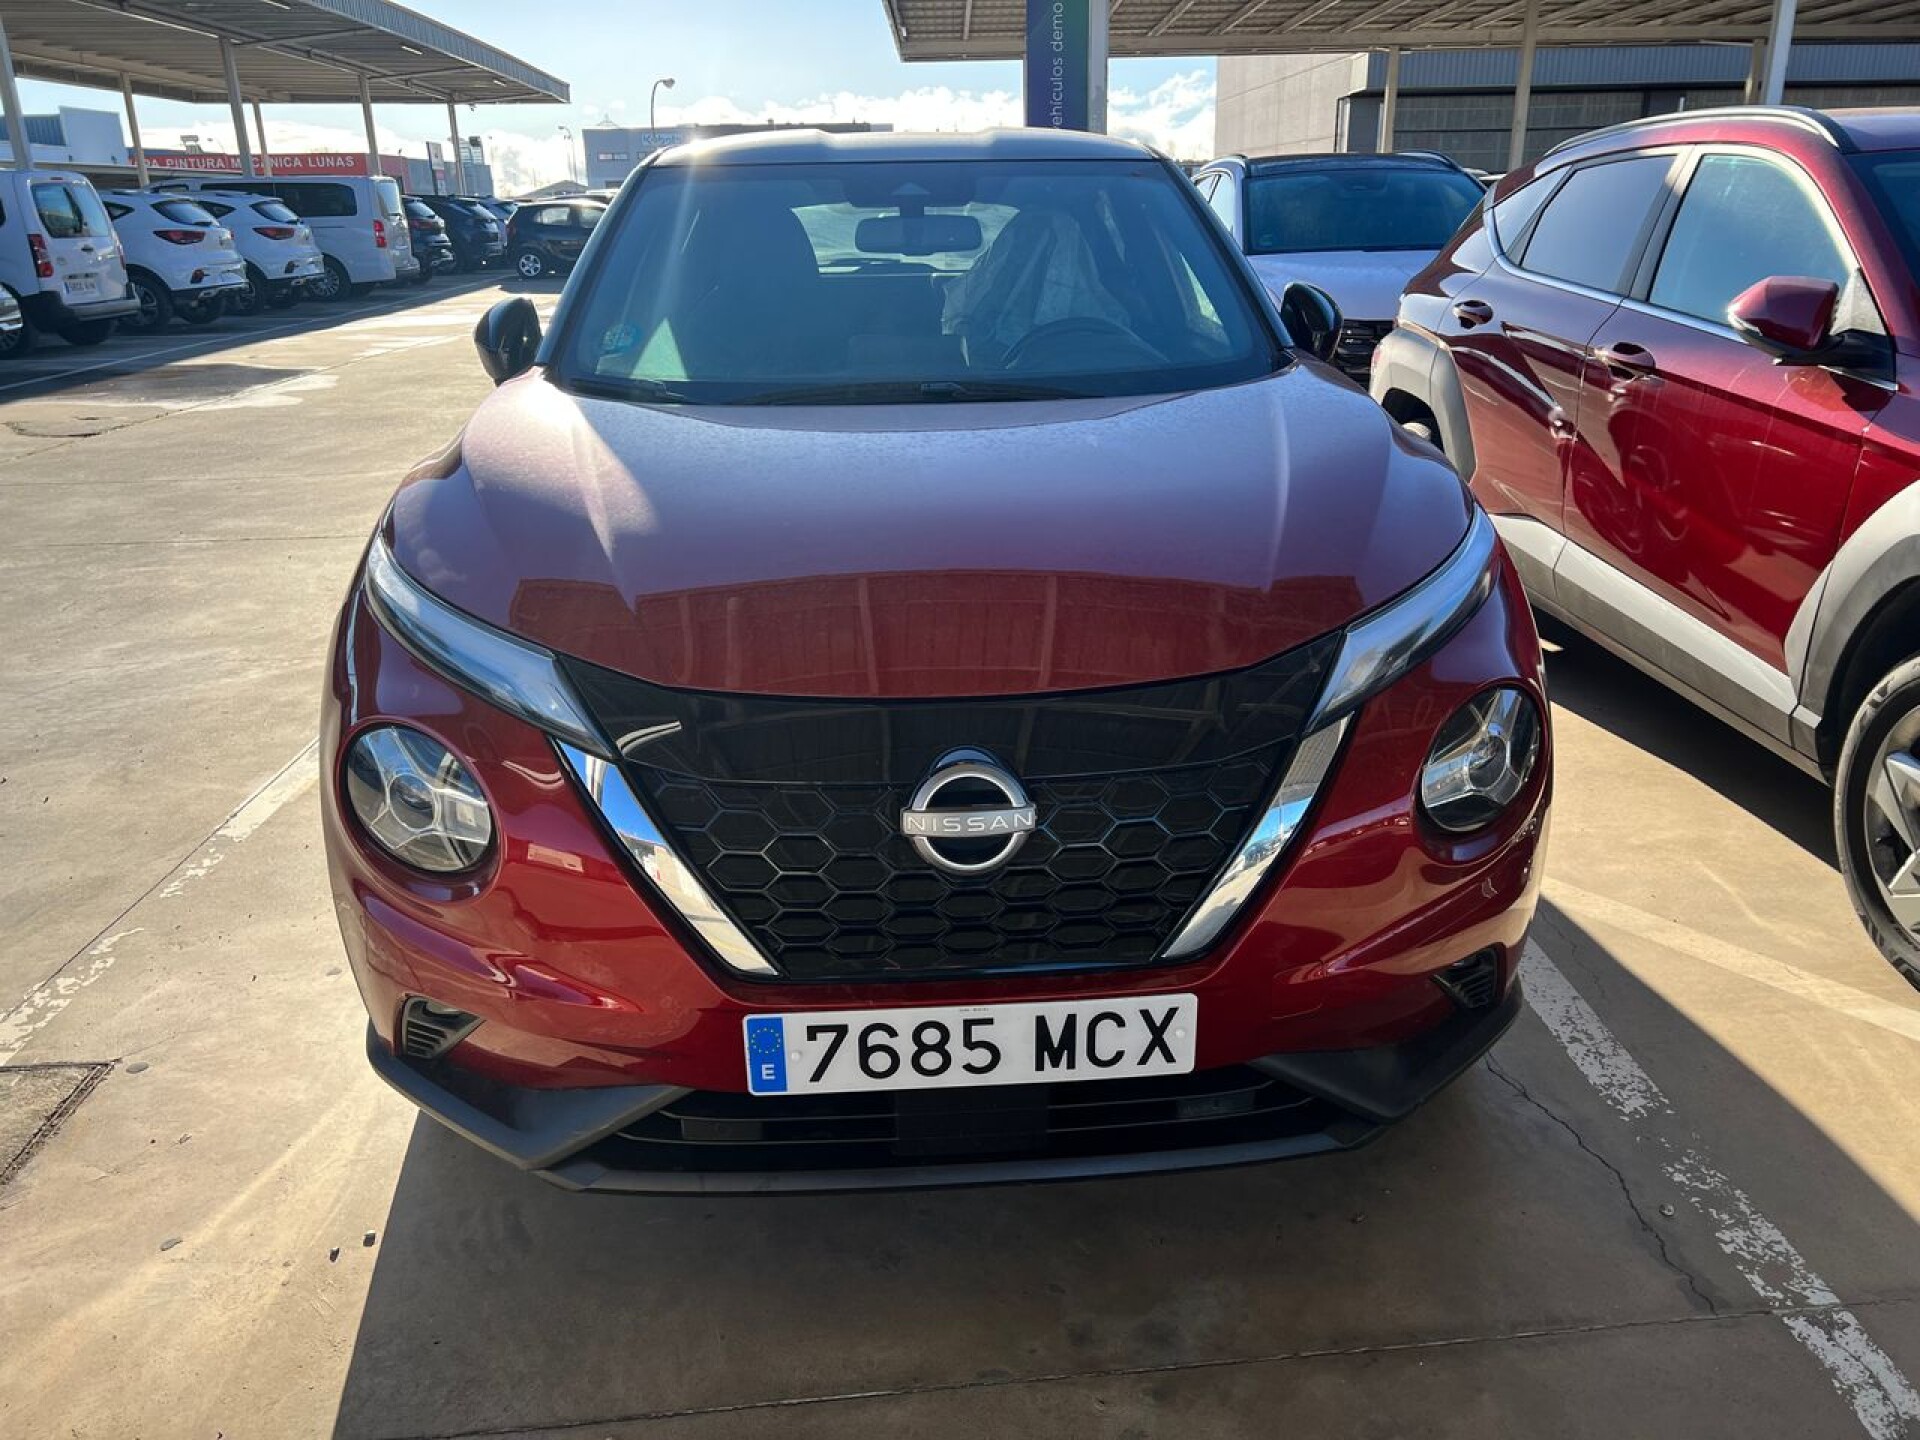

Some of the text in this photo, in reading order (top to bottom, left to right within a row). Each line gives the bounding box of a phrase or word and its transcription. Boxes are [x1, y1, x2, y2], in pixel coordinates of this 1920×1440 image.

[1050, 2, 1063, 129] ehículos demo
[166, 158, 223, 169] PINTURA
[231, 156, 302, 168] MCNICA
[308, 155, 355, 168] LUNAS
[907, 811, 1033, 832] NISSAN
[805, 1006, 1179, 1084] 7685 MCX
[761, 1064, 776, 1080] E
